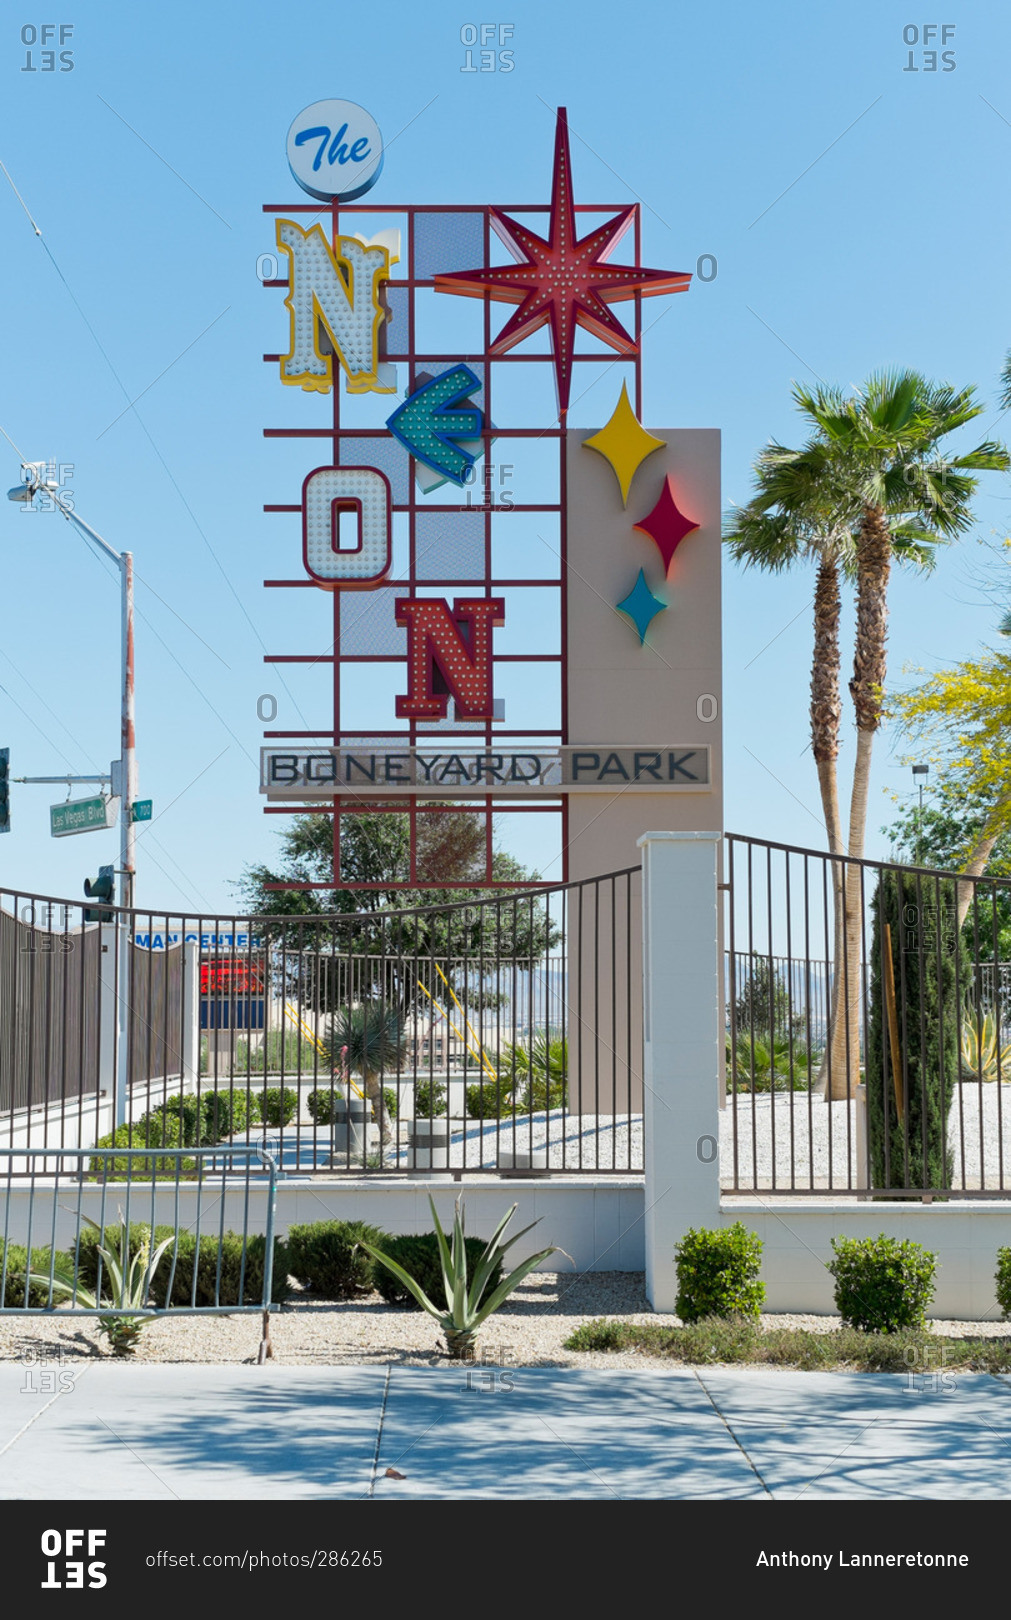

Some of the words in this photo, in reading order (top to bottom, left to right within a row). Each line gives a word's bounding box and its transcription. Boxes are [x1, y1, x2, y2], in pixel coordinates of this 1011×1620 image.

[295, 123, 371, 171] The
[271, 754, 541, 781] BONEYARD
[572, 752, 698, 780] PARK
[53, 814, 64, 828] Las
[65, 808, 85, 826] Vegas
[88, 805, 104, 821] Blvd
